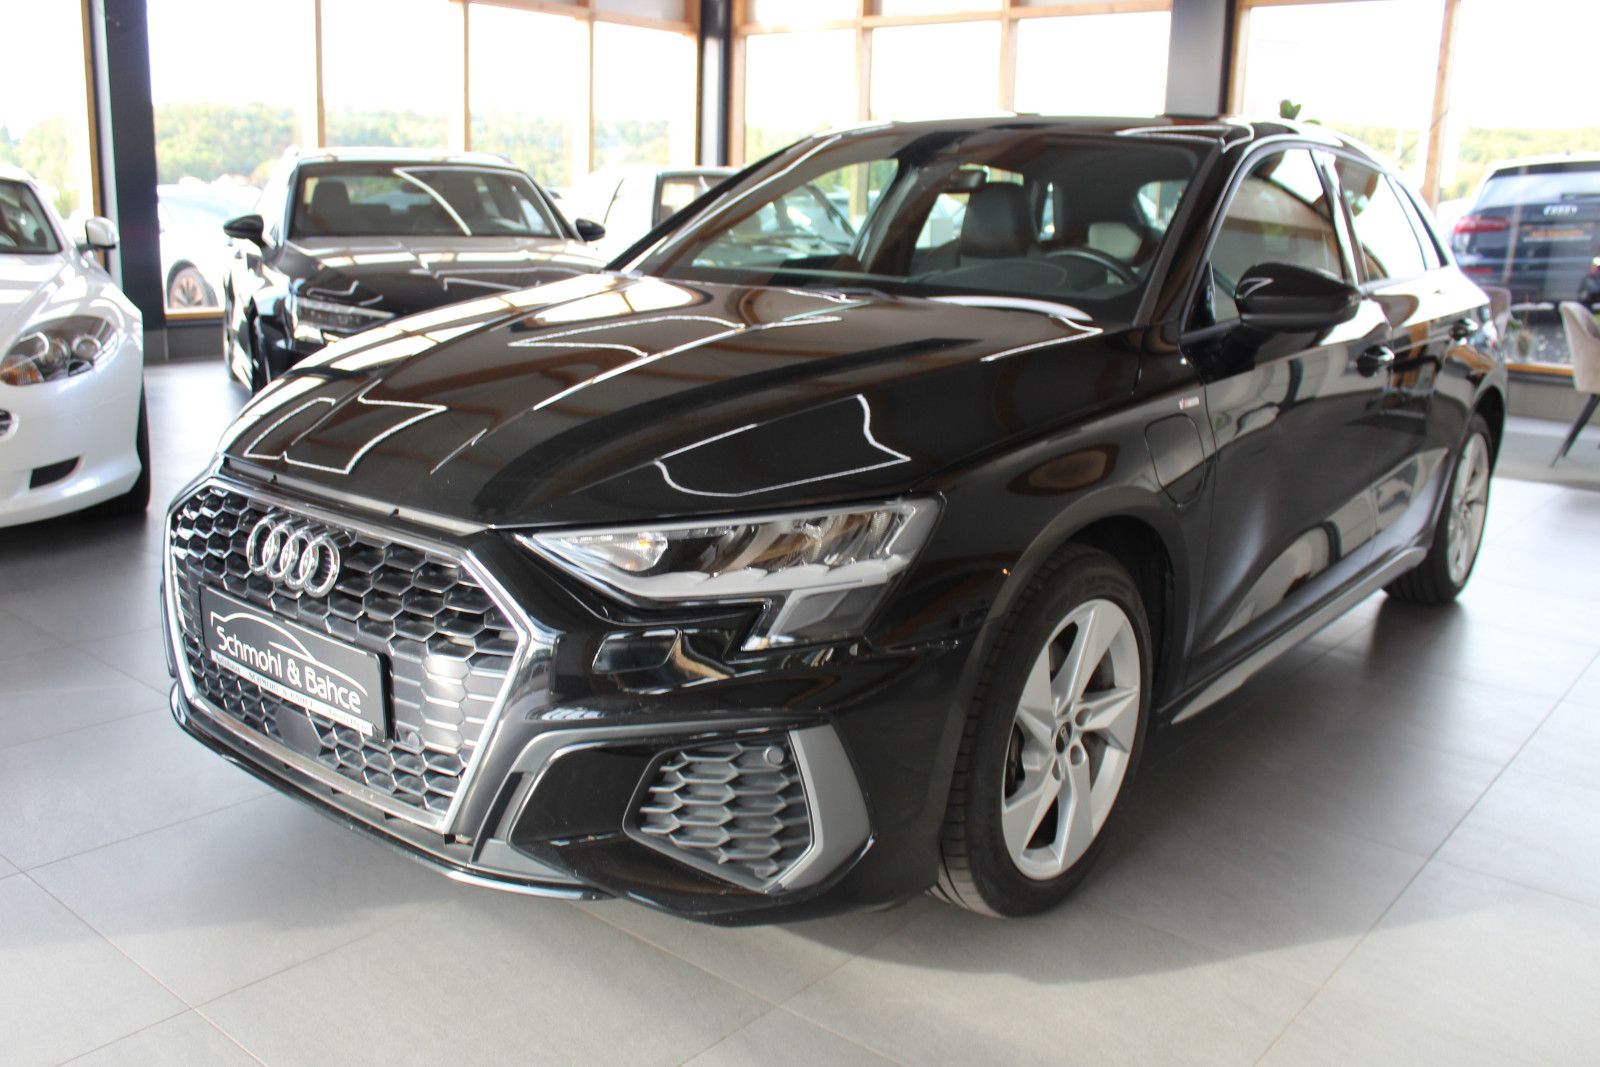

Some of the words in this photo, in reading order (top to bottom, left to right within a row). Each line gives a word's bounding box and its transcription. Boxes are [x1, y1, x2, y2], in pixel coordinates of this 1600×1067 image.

[216, 625, 283, 678] Schmohl
[287, 658, 302, 688] &
[304, 666, 362, 714] Bahce
